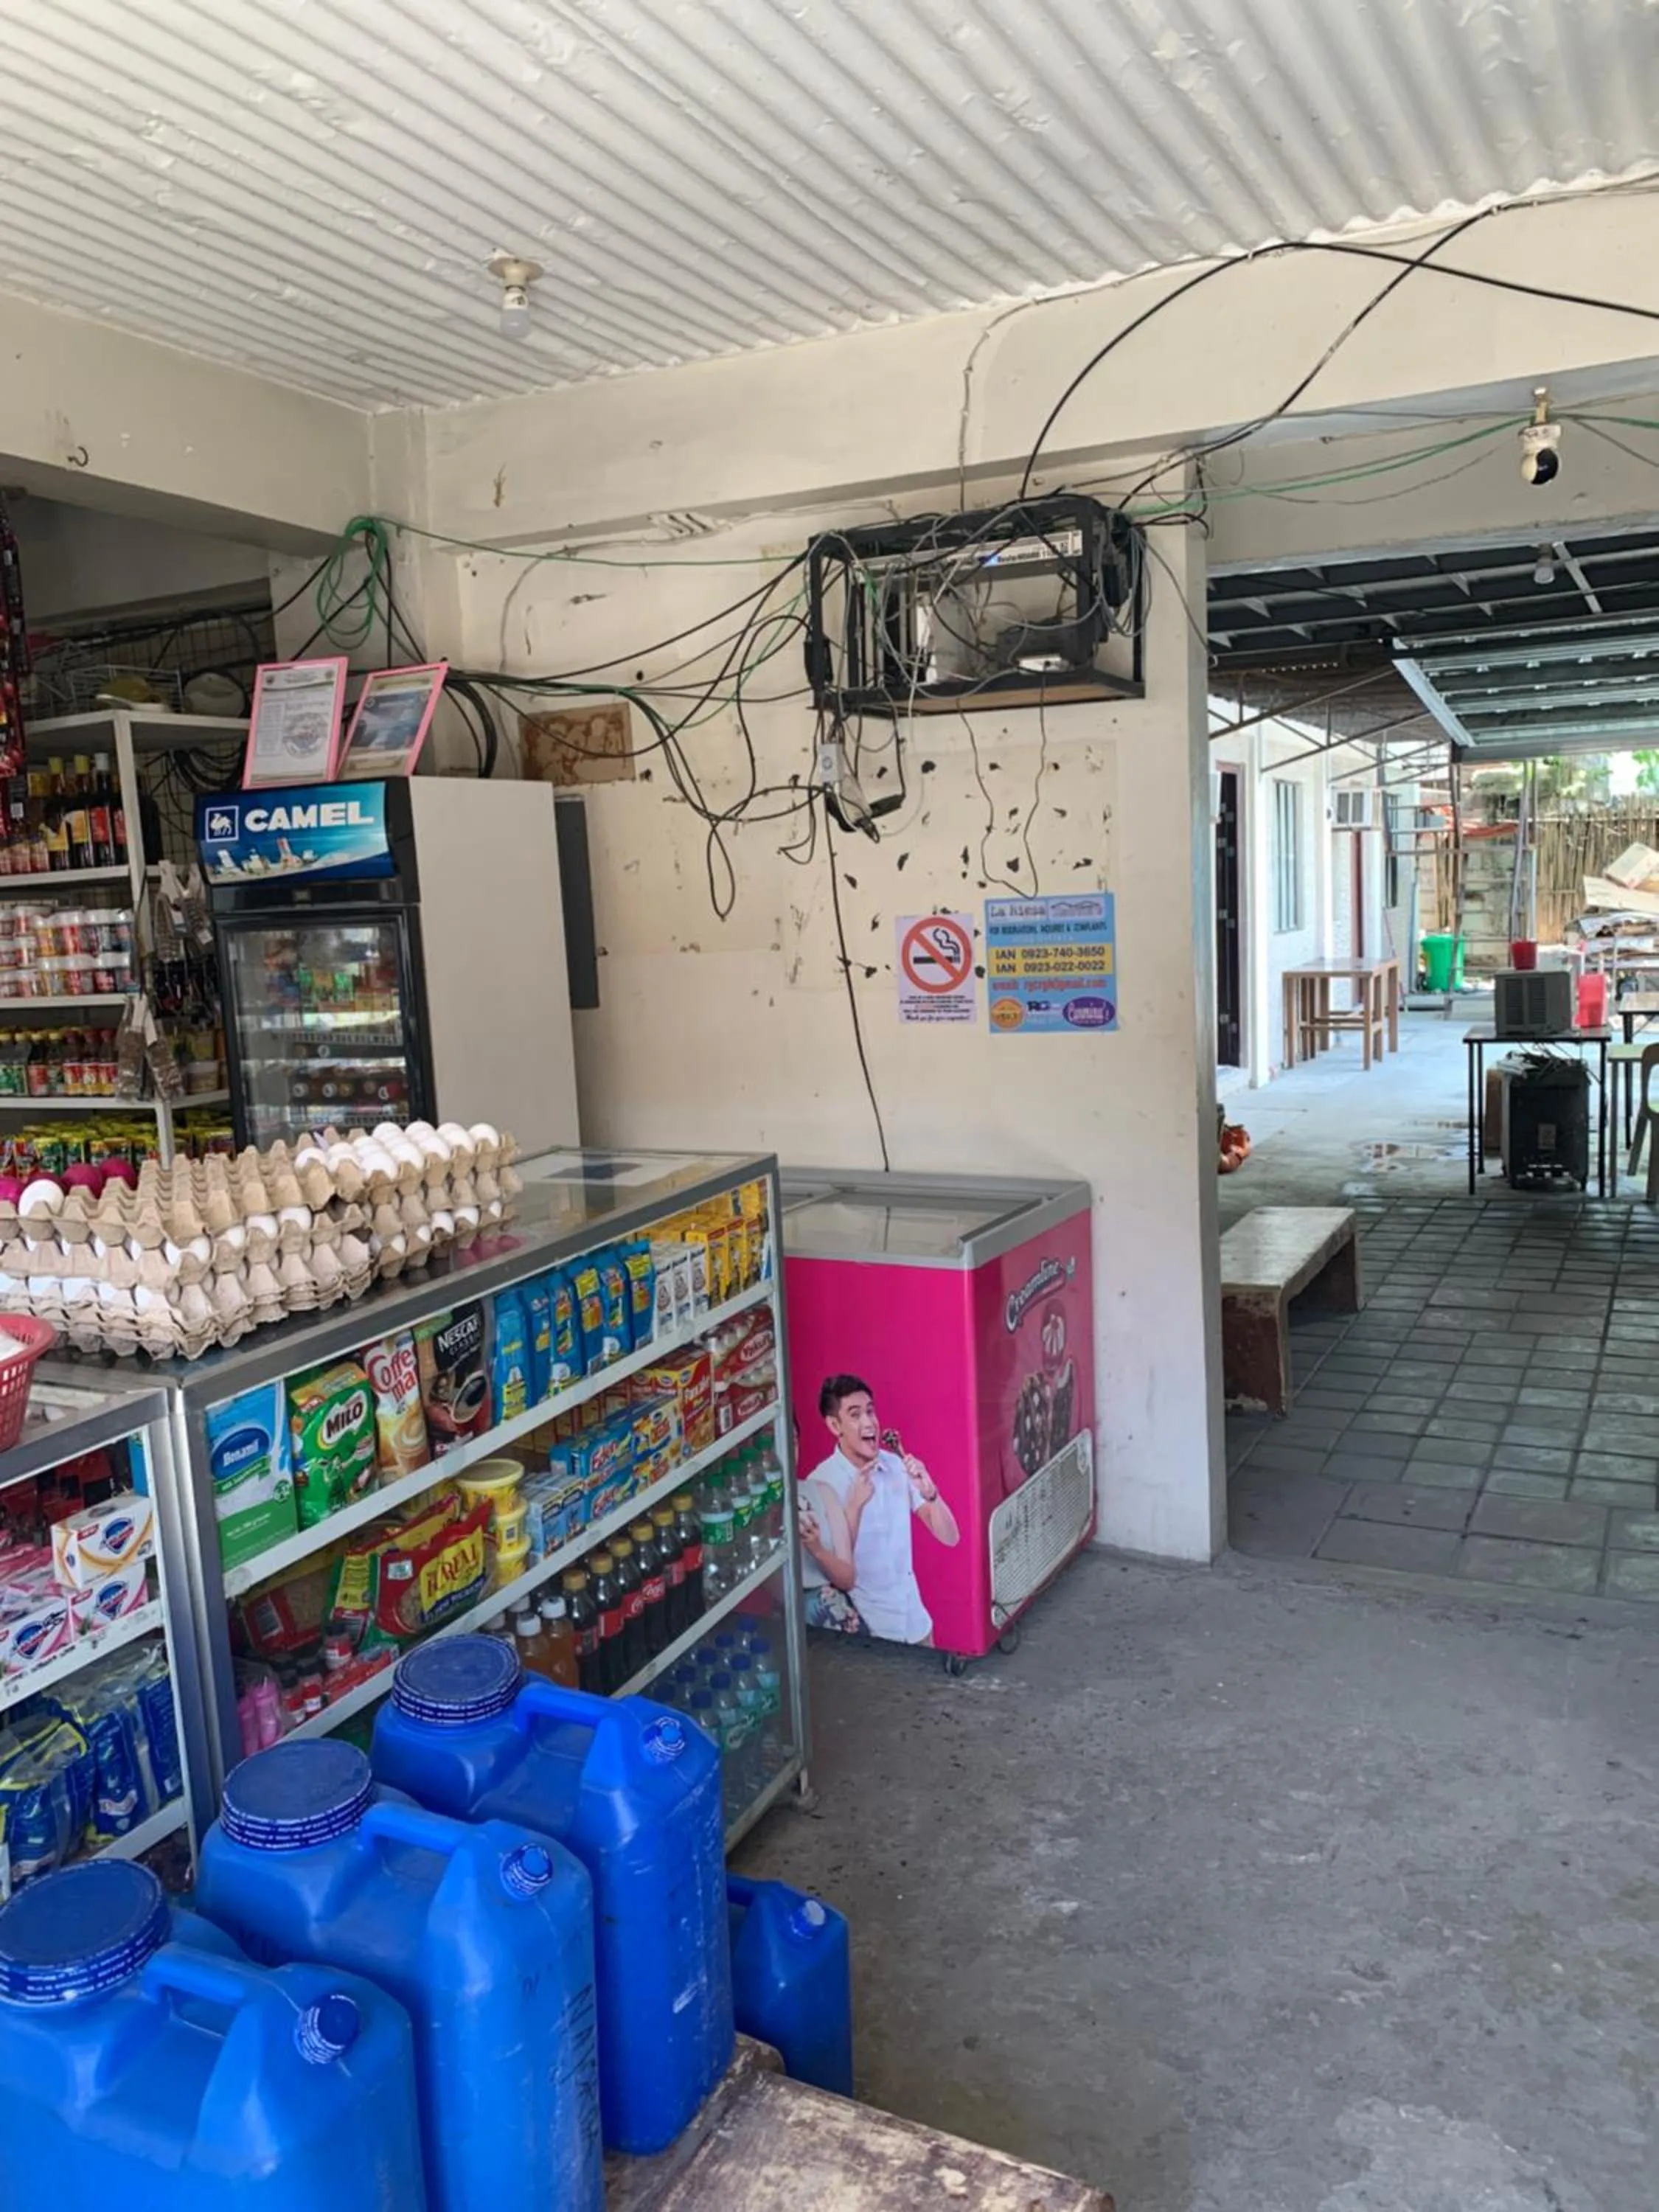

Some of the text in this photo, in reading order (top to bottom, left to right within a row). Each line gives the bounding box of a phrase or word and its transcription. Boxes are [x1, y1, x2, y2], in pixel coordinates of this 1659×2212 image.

[245, 801, 374, 832] CAMEL
[437, 1313, 480, 1354] NESCAF
[449, 1332, 477, 1356] CLASSI
[366, 1348, 412, 1394] Coffe
[391, 1371, 416, 1403] ma
[327, 1402, 363, 1439] MILO
